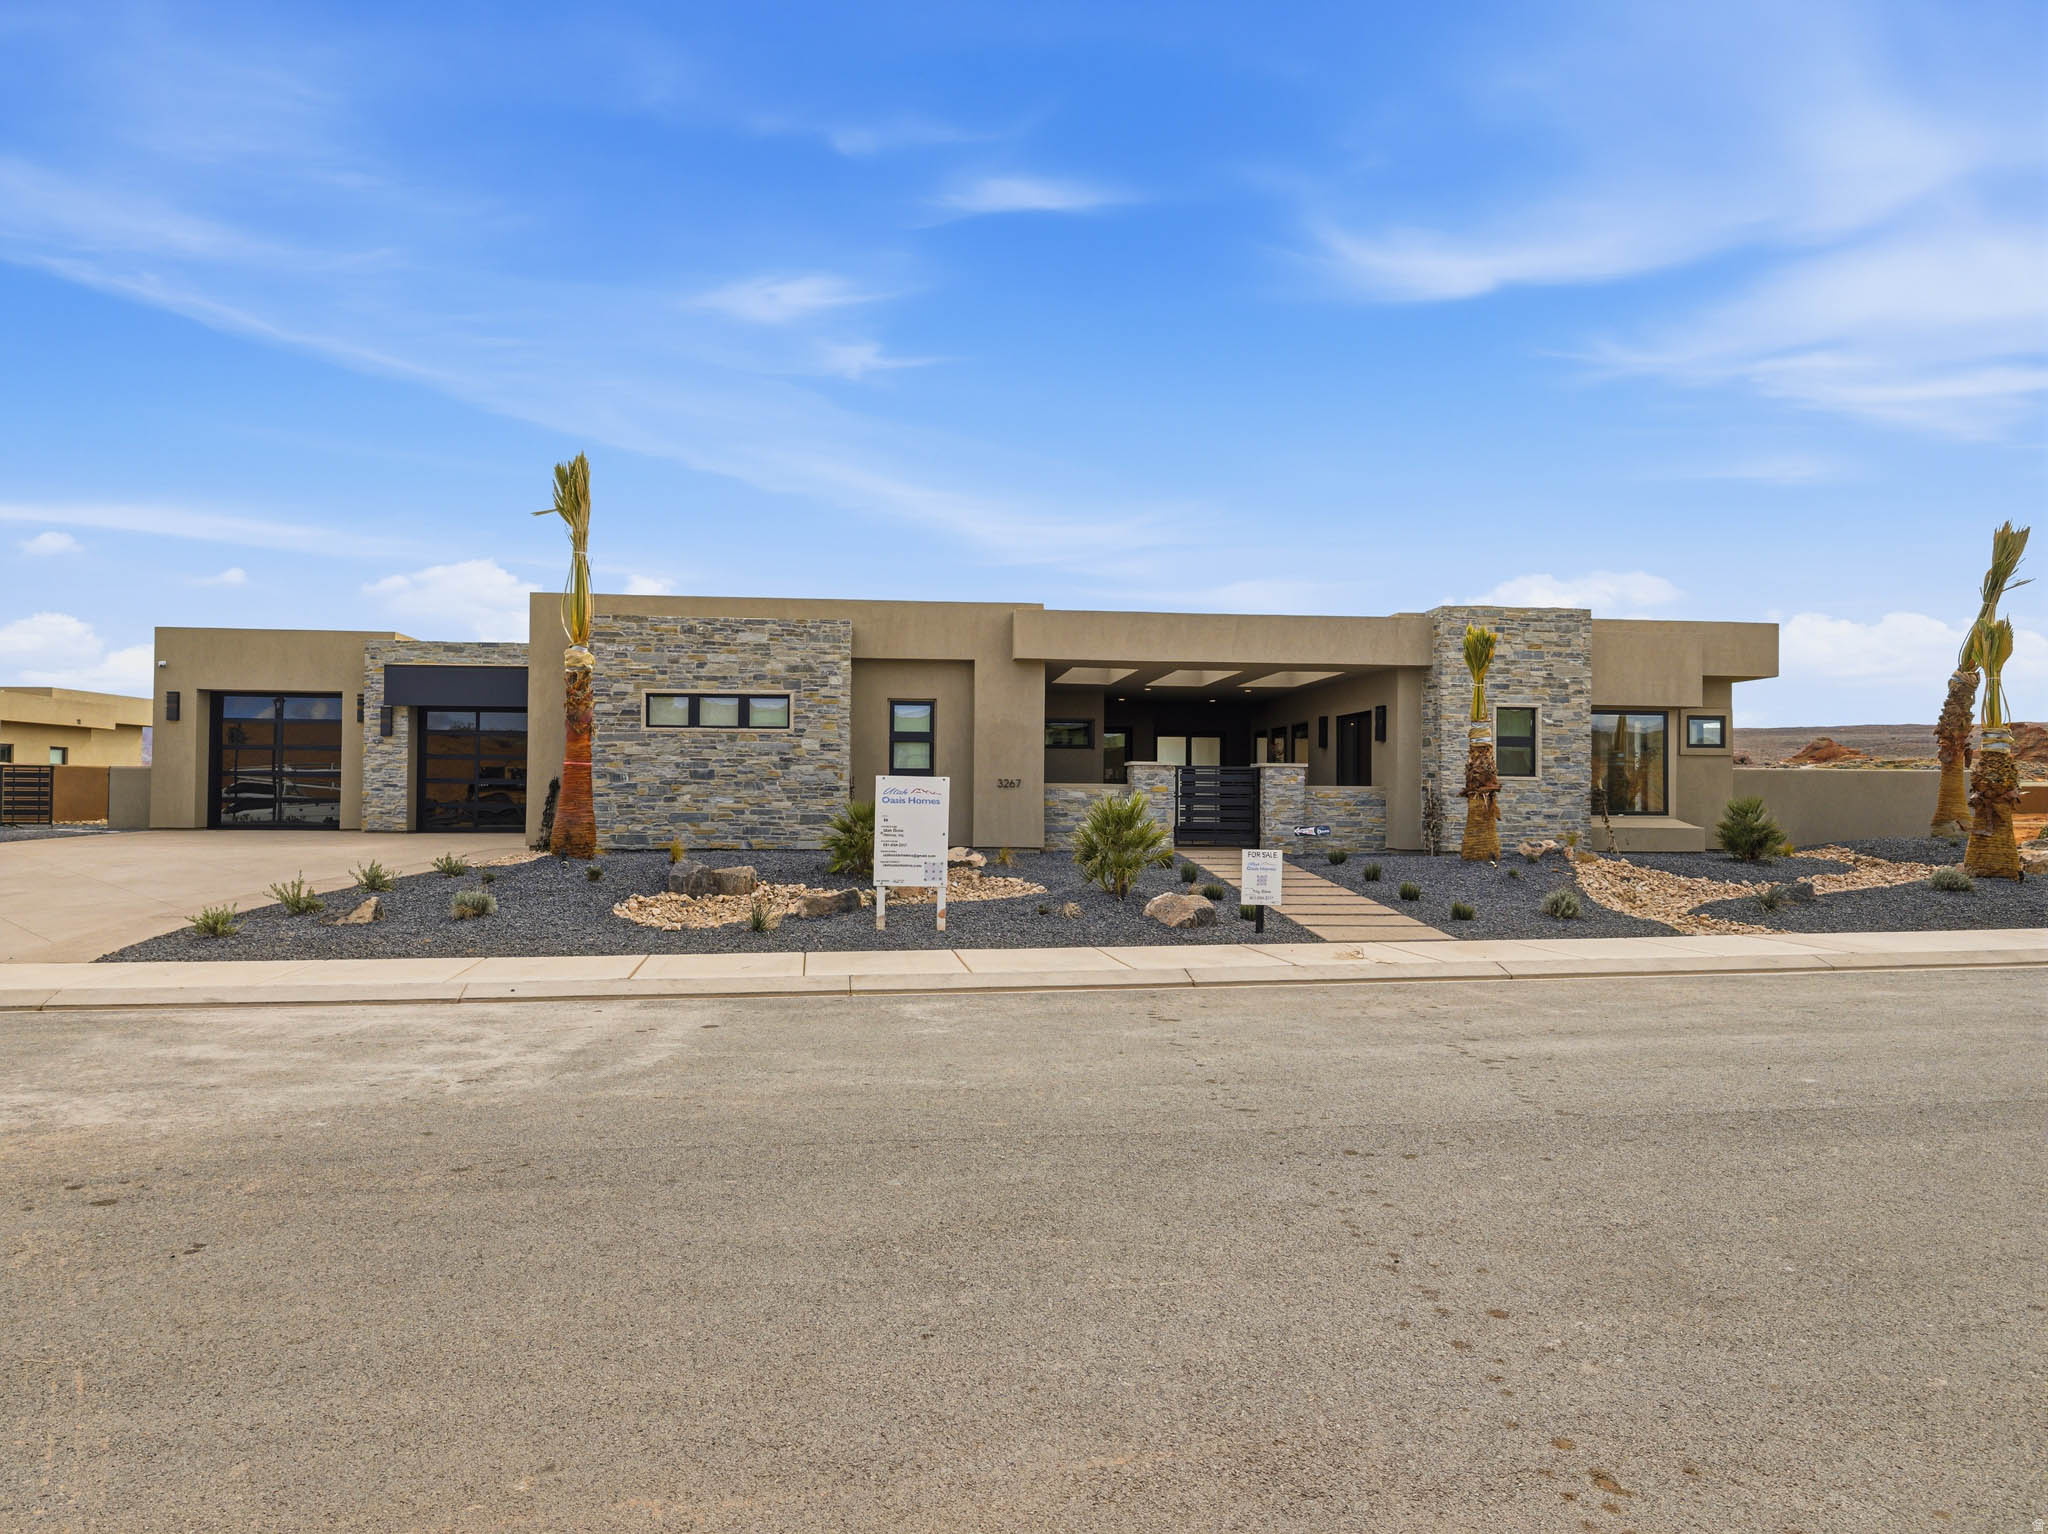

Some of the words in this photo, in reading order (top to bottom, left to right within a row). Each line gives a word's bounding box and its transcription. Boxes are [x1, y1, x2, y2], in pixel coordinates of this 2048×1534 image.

[997, 778, 1021, 788] 3267
[883, 787, 908, 795] Utah
[882, 796, 906, 804] Oasis
[908, 797, 940, 805] Homes
[1262, 851, 1279, 859] SALE
